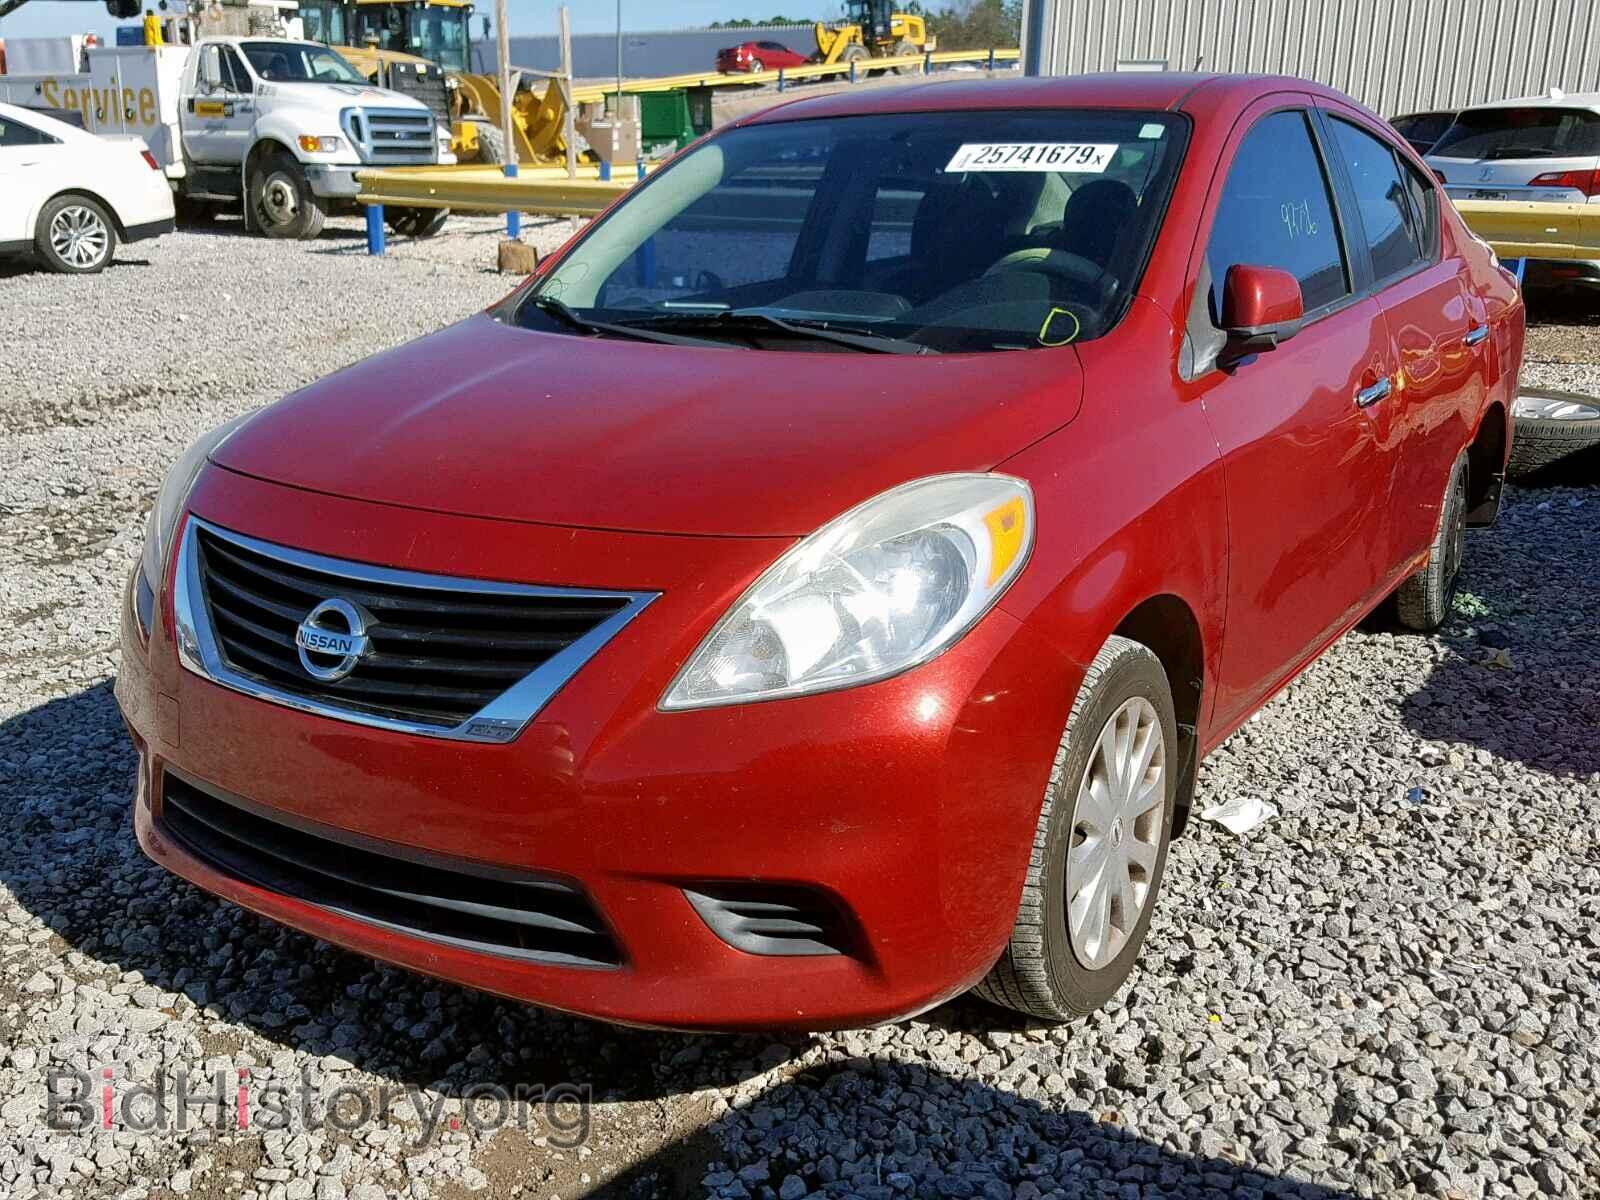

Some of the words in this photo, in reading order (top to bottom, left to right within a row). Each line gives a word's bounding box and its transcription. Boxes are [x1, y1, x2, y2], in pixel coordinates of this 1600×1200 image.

[42, 78, 156, 128] Service
[972, 144, 1096, 165] 25741679
[297, 630, 353, 653] NISSAN
